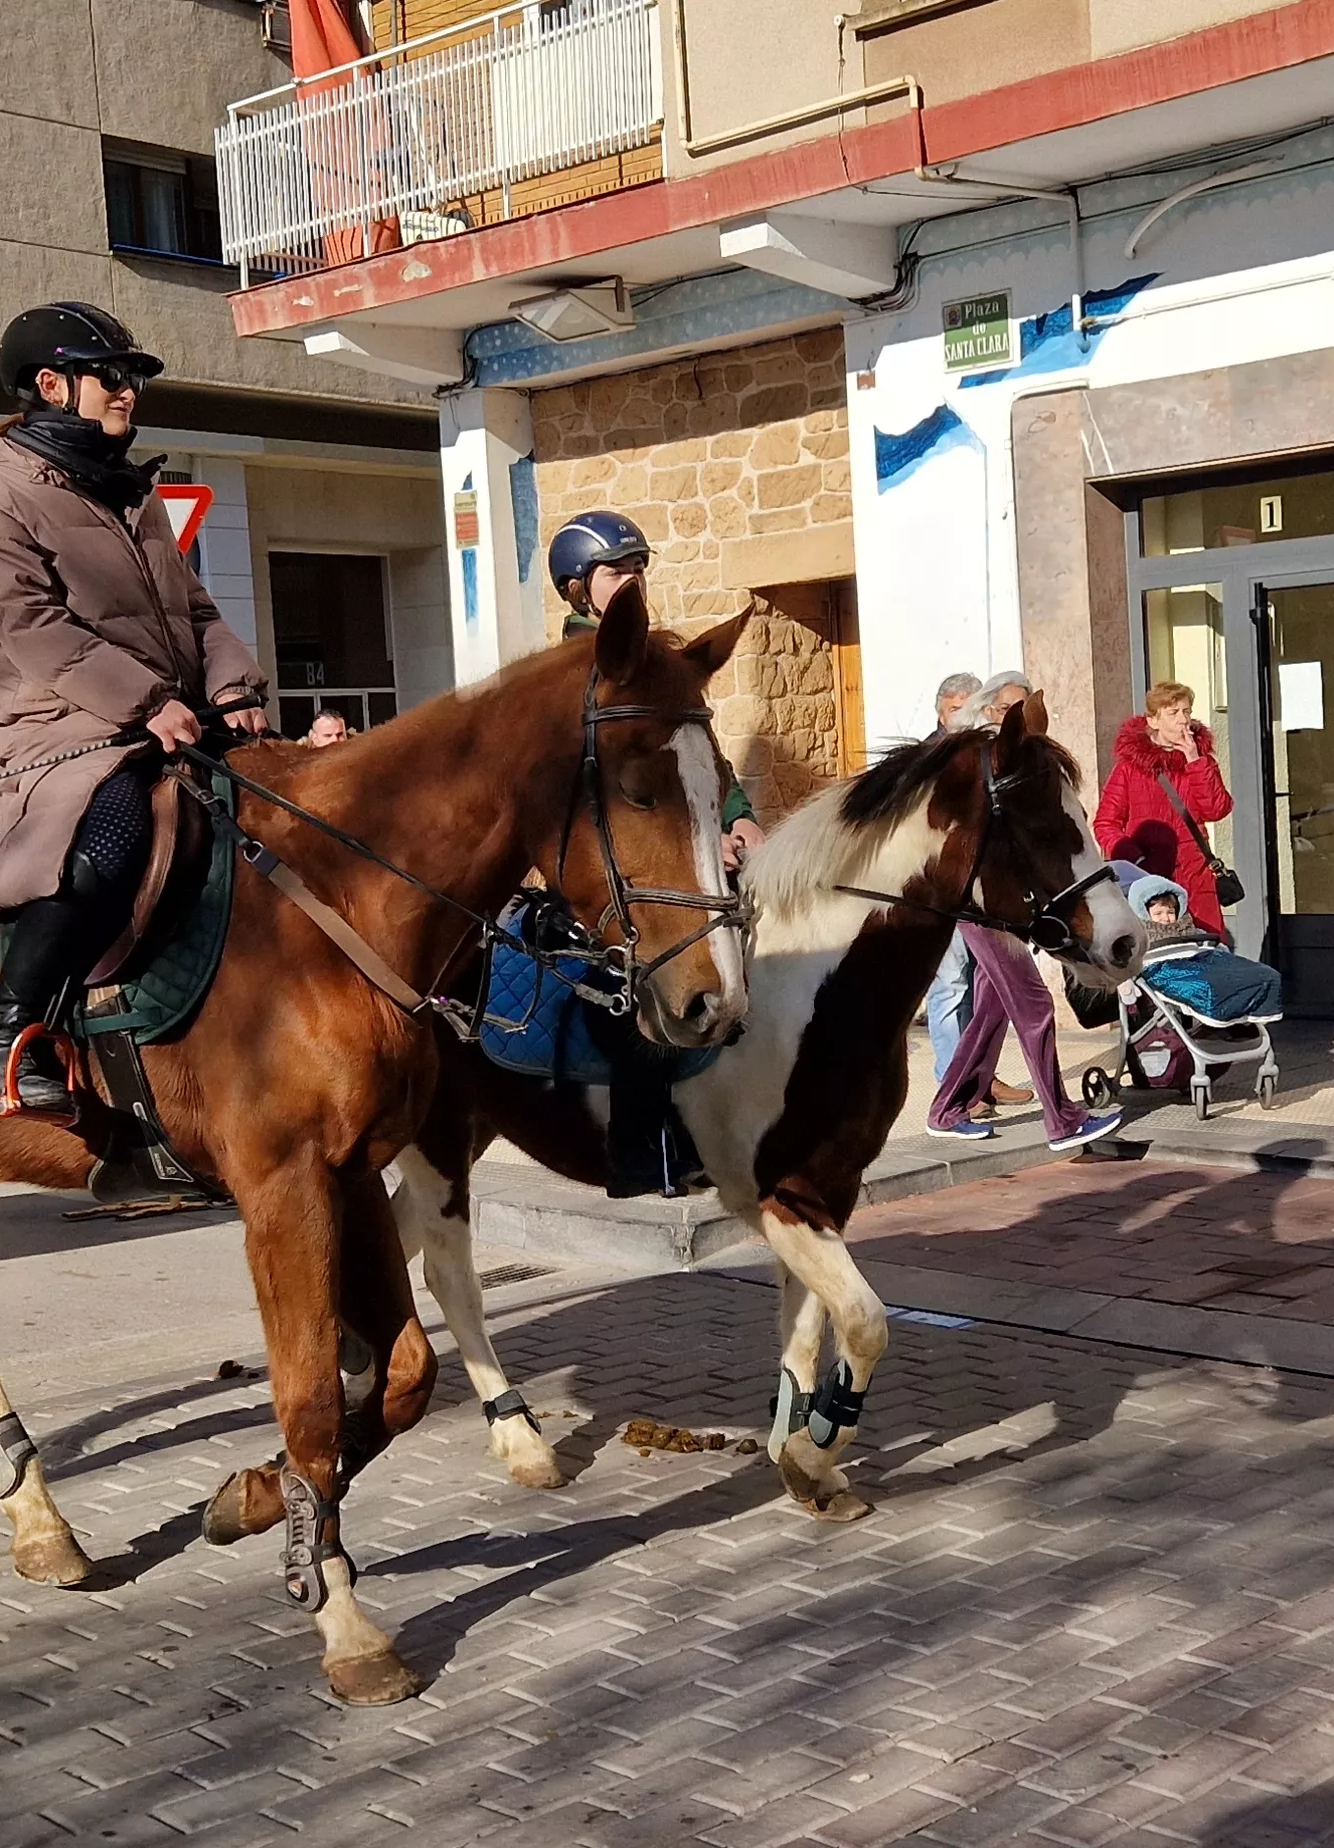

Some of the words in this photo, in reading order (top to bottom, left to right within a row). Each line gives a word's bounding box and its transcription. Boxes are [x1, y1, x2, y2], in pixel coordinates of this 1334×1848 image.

[965, 301, 999, 319] Plaza
[945, 339, 975, 361] SANTA
[977, 332, 1009, 356] CLARA
[1265, 500, 1278, 528] 1
